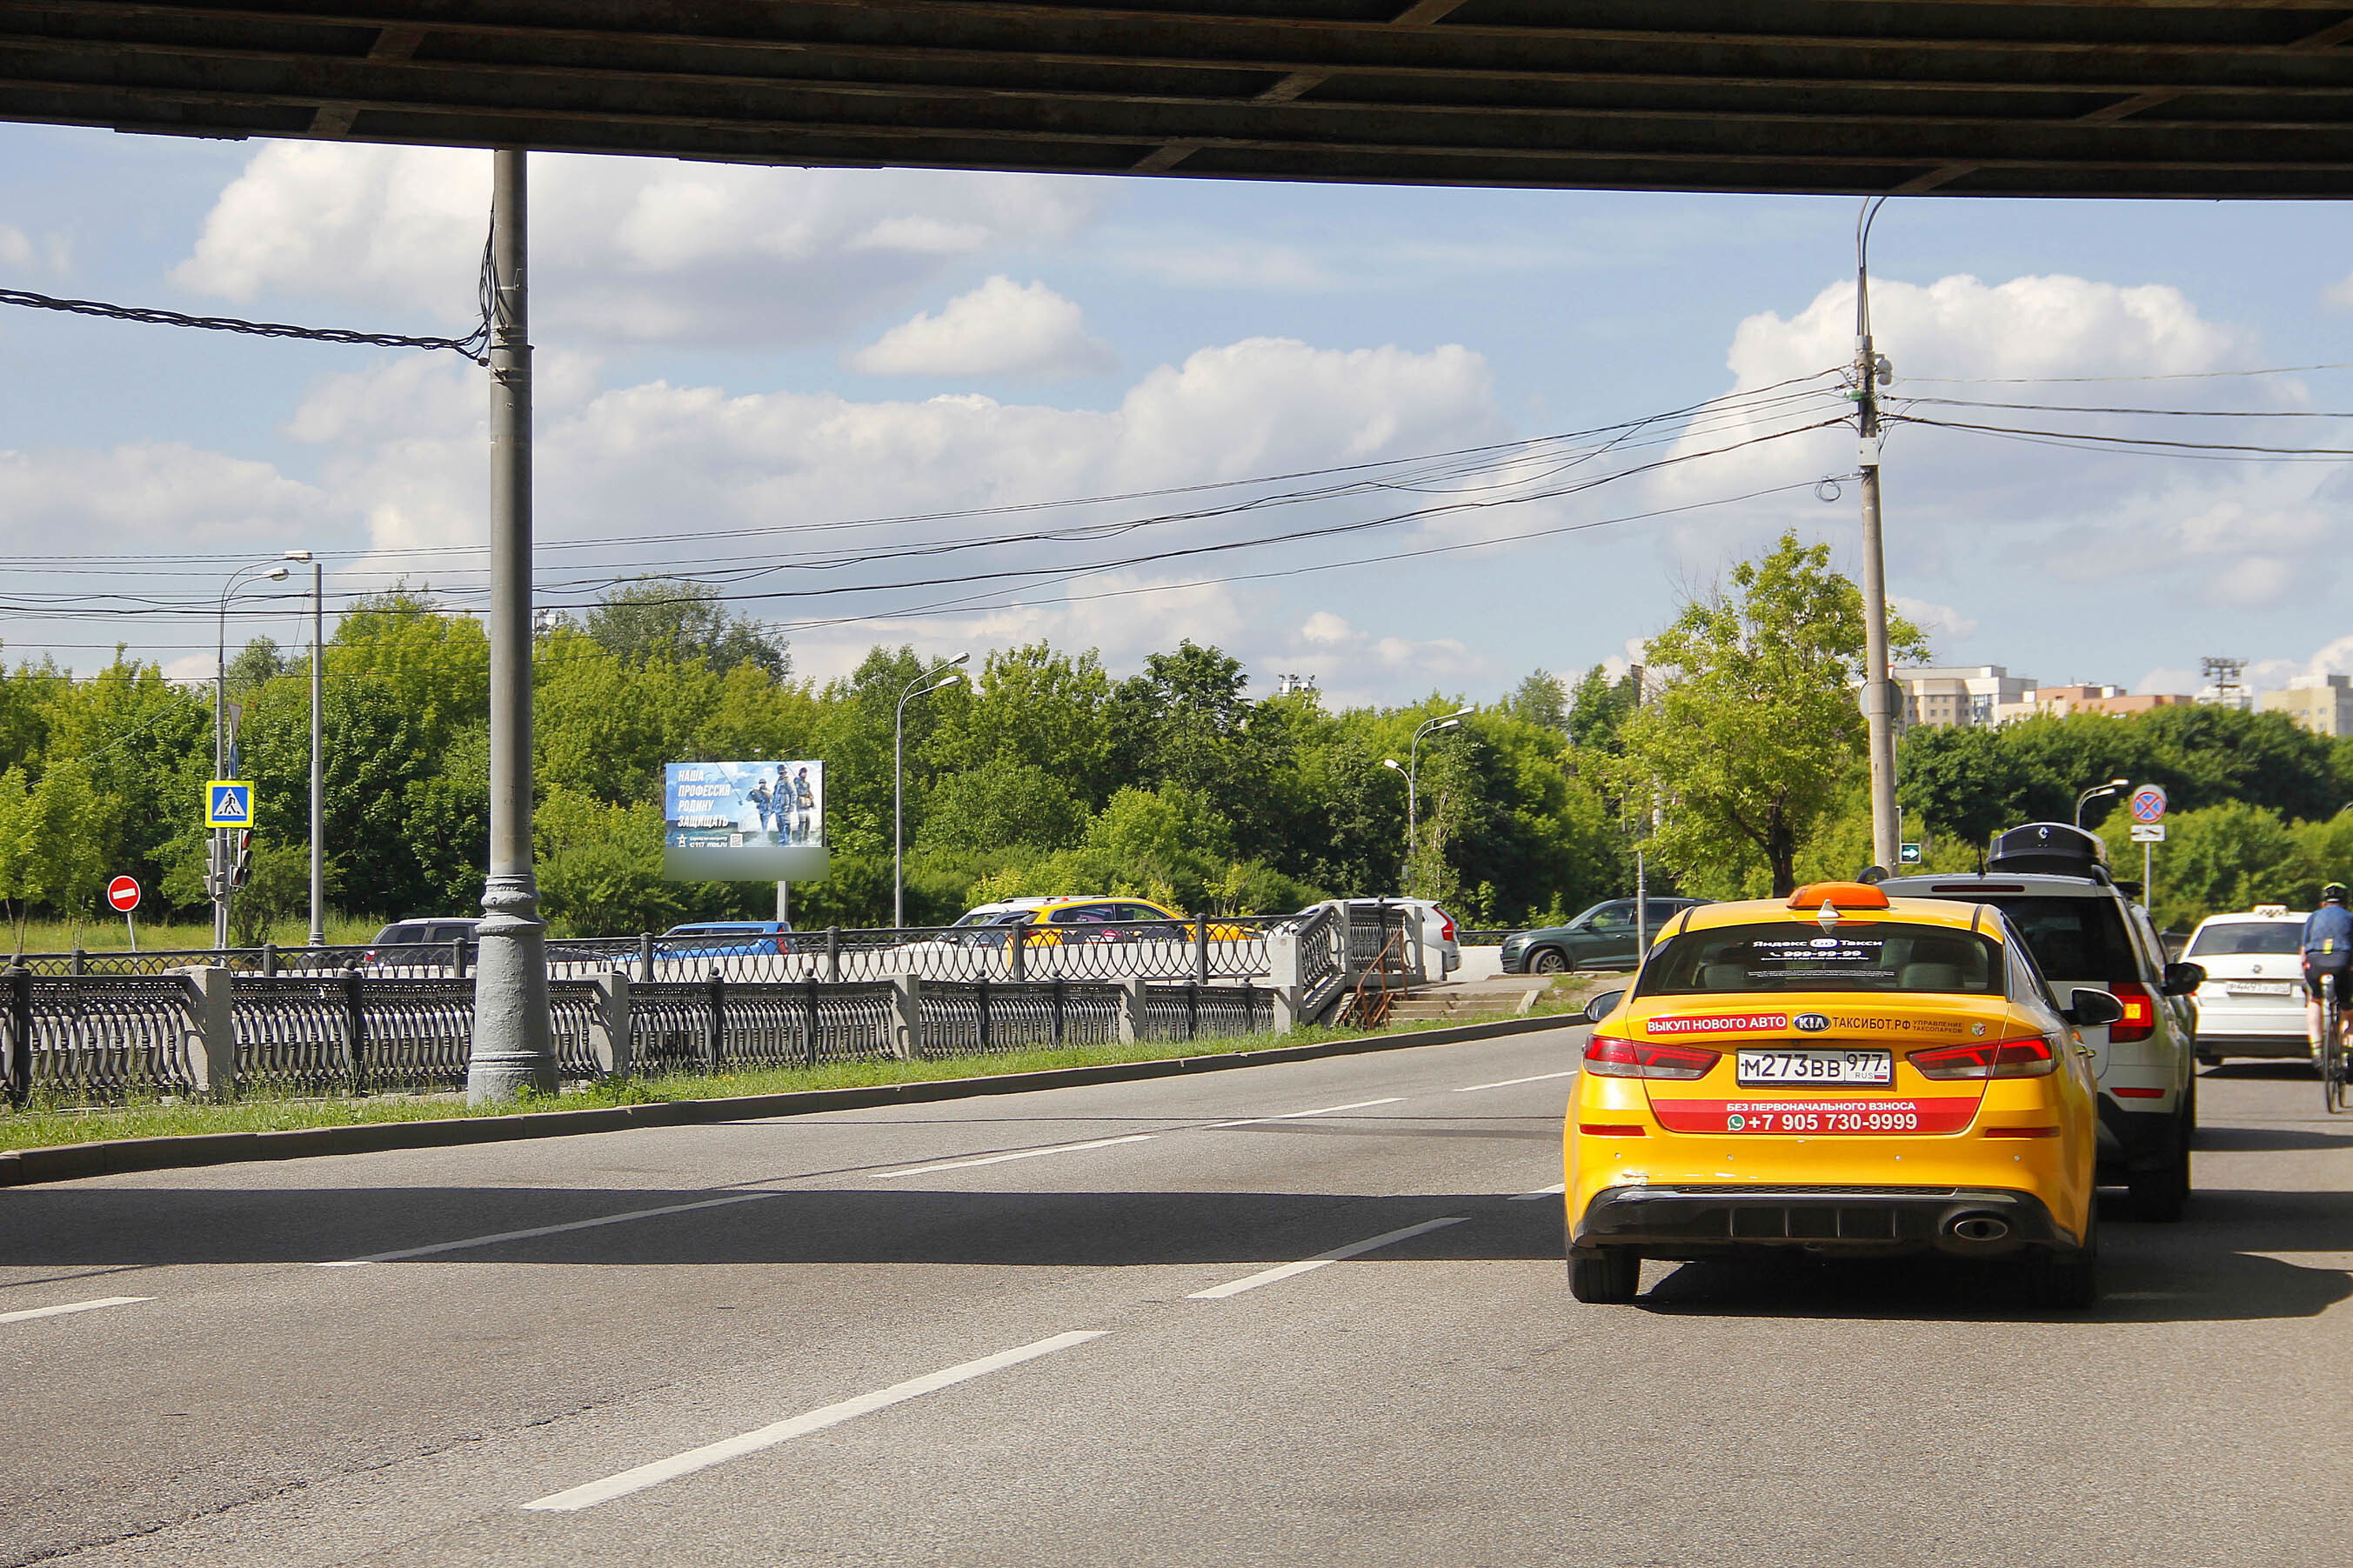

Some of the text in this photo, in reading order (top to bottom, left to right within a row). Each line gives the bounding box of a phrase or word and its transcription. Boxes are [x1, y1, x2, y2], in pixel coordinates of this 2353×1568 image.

[678, 770, 704, 782] НАША
[678, 784, 731, 797] ПРОФЕССИЯ
[678, 800, 714, 813] РОДИНУ
[678, 815, 729, 829] ЗАЩИЩАТЬ
[1648, 1016, 1787, 1032] ВЫКУП НОВОГО АВТО
[1798, 1017, 1826, 1030] KIA
[1833, 1017, 1911, 1031] ТАКСИБОТ.РФ
[1846, 1053, 1883, 1071] 977
[1727, 1102, 1916, 1111] БЕЗ ПЕРВОНАЧАЛЬНОГО ВЗНОСА
[1748, 1112, 1918, 1131] +7 905 730-9999
